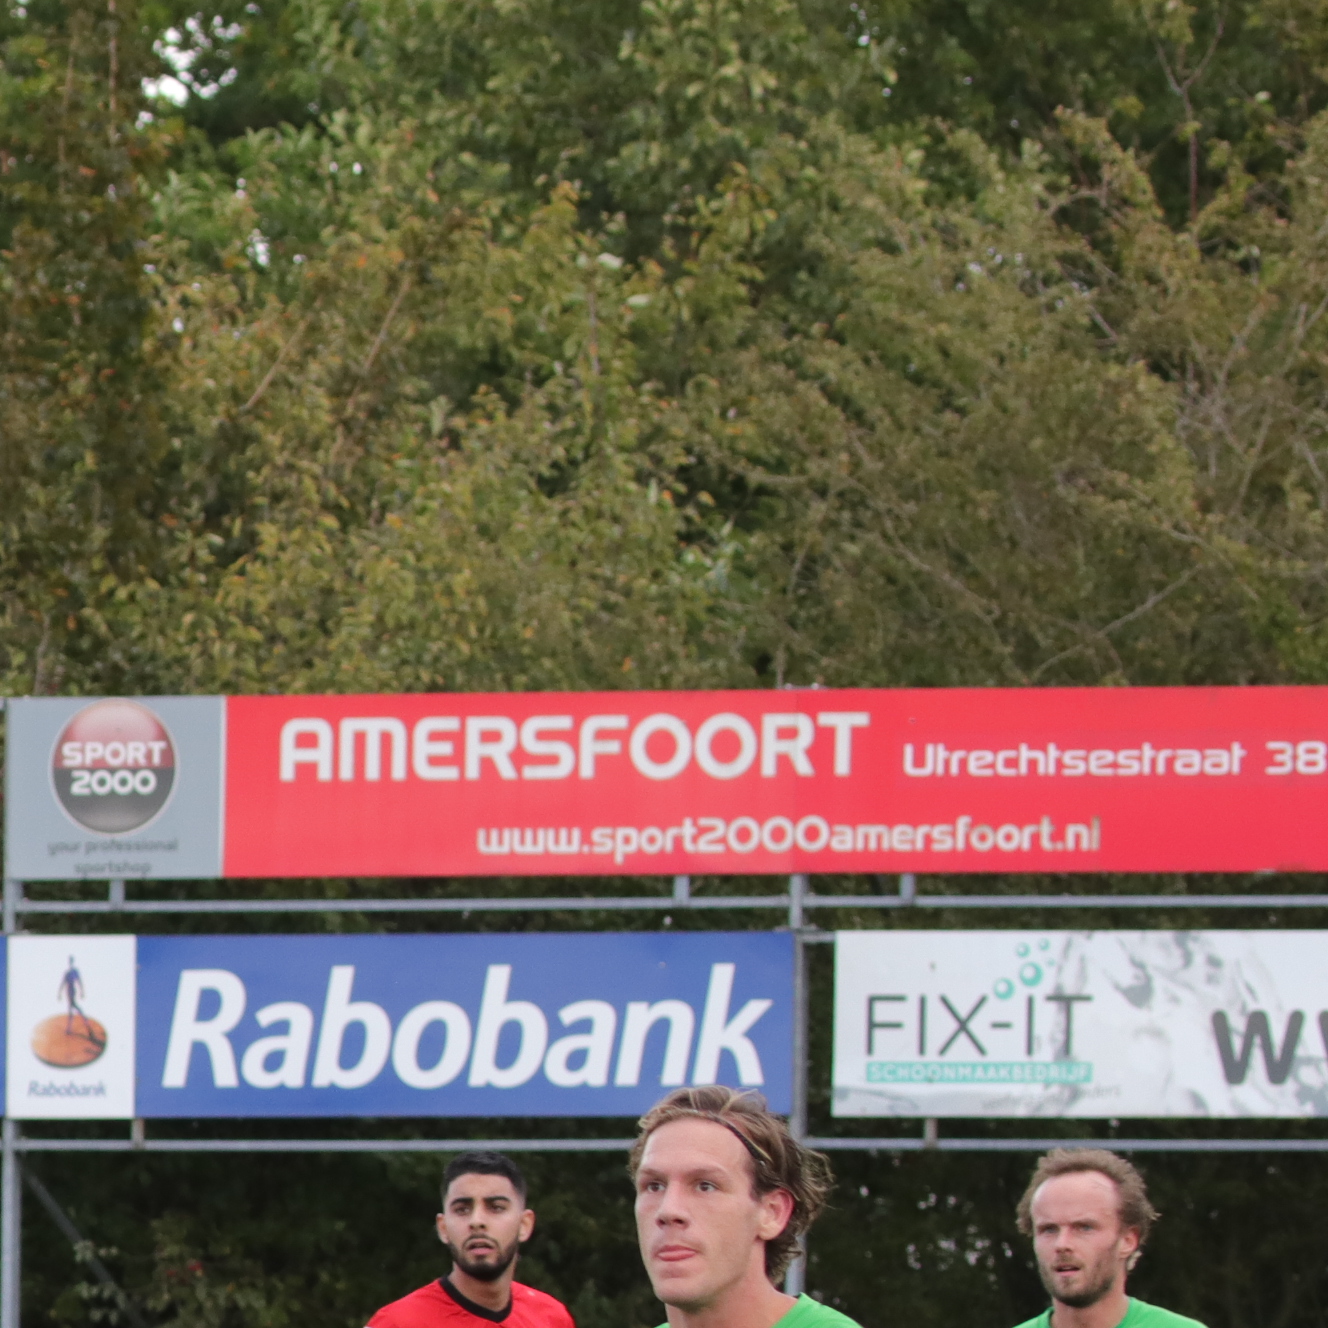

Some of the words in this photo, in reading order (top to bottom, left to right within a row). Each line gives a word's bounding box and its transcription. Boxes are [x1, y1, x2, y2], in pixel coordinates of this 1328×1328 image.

[62, 741, 166, 767] SPORT
[279, 711, 870, 783] AMERSFOORT
[902, 741, 1246, 777] Utrechtsestraat
[70, 769, 157, 795] 2000
[477, 815, 1100, 864] www.sport2000amersfoort.nl
[162, 962, 772, 1089] Rabobank
[867, 994, 1093, 1057] FIX-IT
[28, 1080, 108, 1099] Rabobank
[869, 1062, 1089, 1083] SCHOONMAAKBEDRIJF
